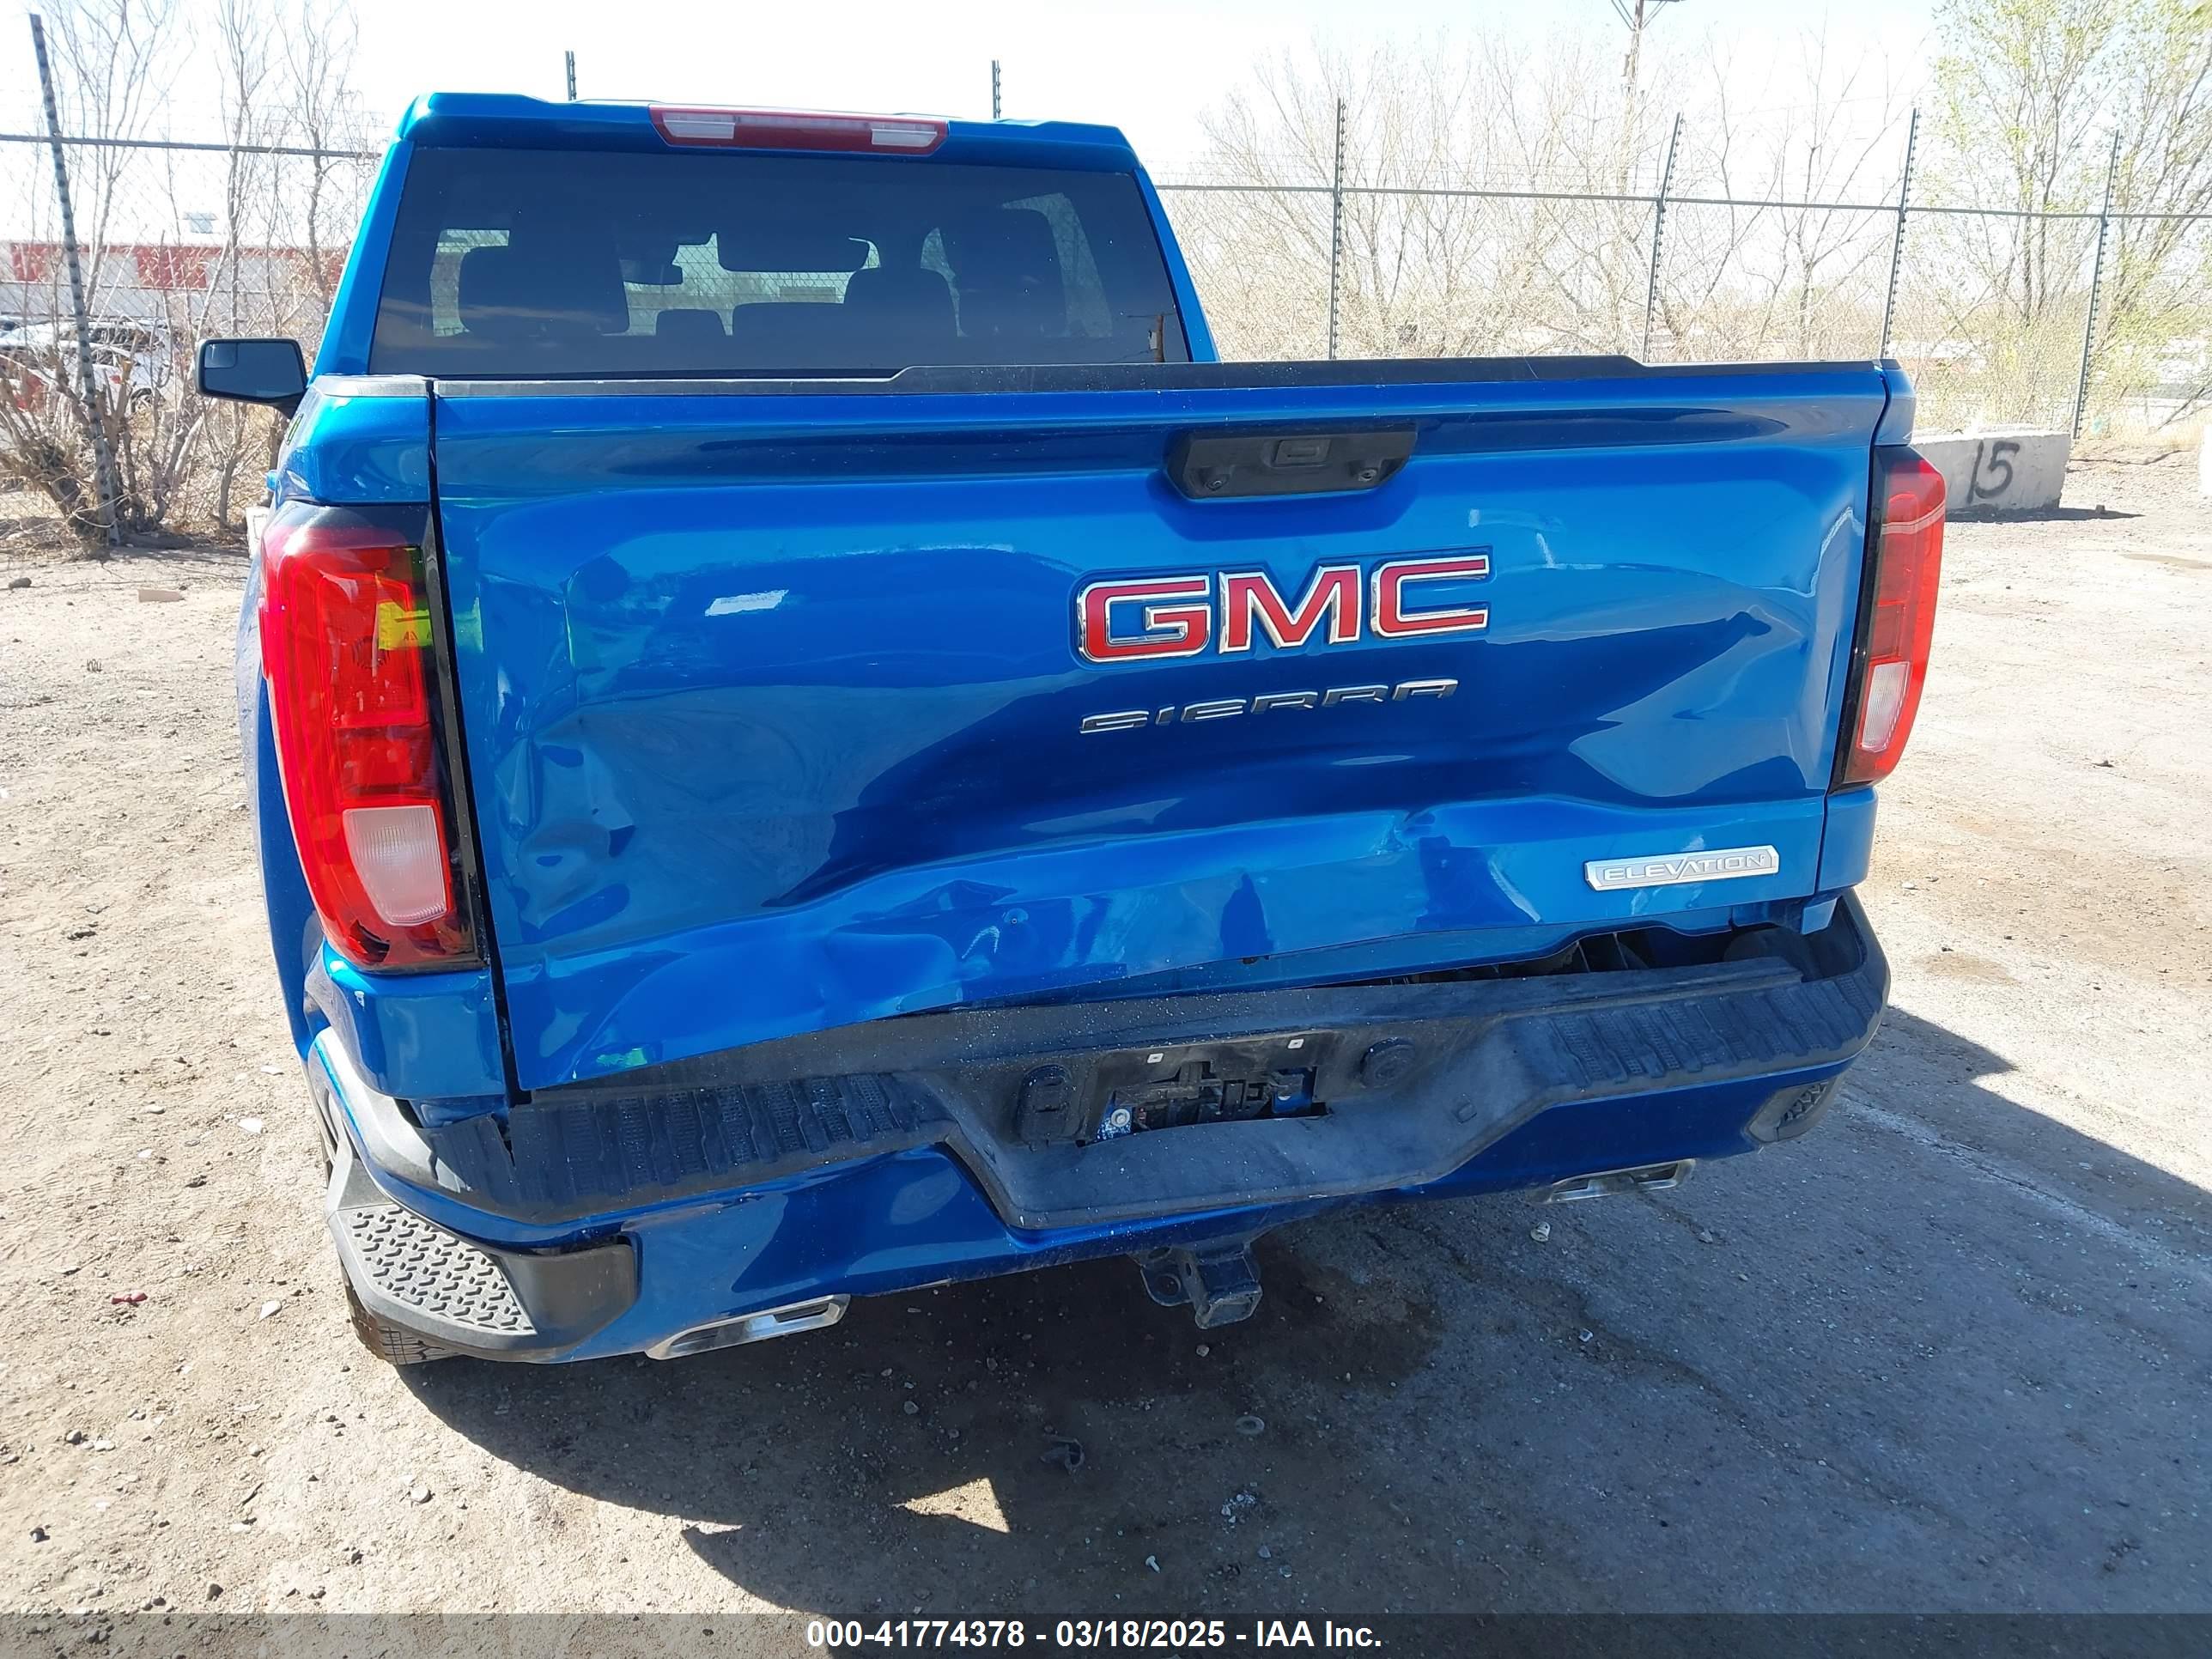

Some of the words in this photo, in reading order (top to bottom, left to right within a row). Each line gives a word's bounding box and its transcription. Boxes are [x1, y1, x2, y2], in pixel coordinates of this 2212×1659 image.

[1966, 440, 2021, 504] 15
[1076, 554, 1490, 664] GMC
[1079, 678, 1459, 734] SIERRA
[1603, 854, 1765, 882] ELEVATION
